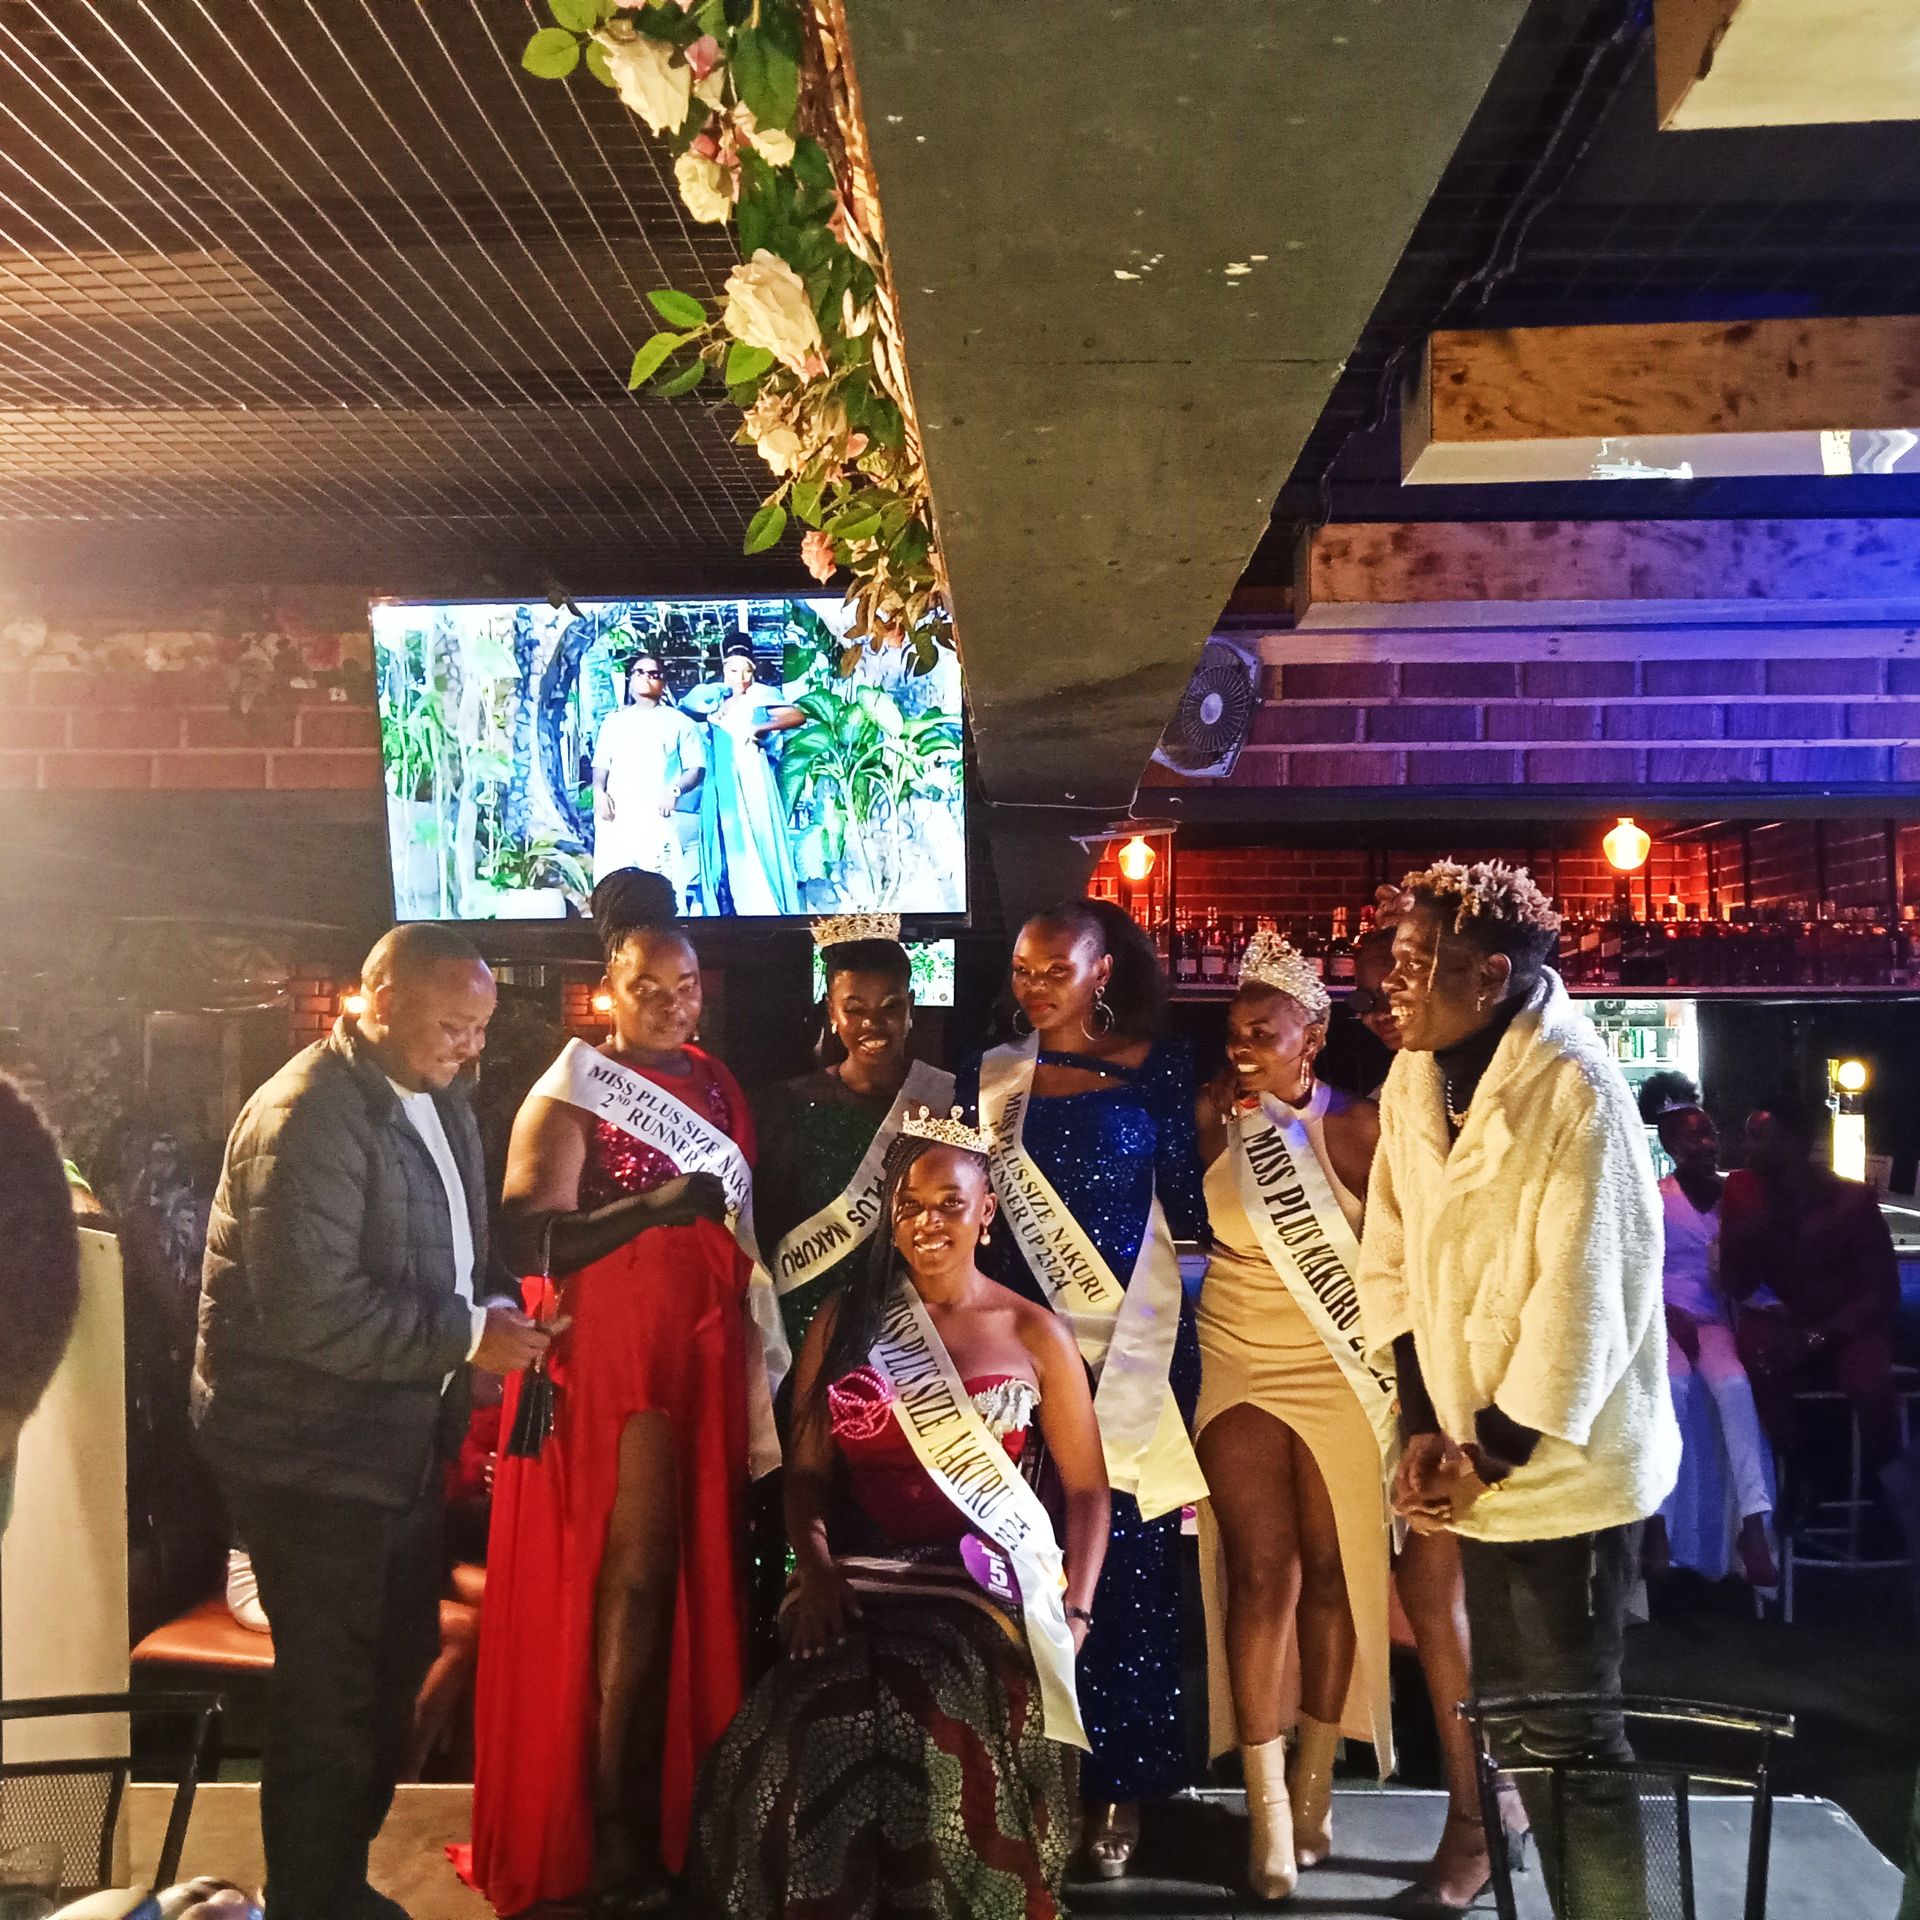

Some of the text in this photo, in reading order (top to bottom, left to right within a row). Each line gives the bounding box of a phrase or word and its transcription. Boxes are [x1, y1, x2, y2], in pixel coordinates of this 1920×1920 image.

[588, 1065, 636, 1096] MISS
[636, 1089, 683, 1125] PLUS
[682, 1120, 720, 1158] SIZE
[626, 1107, 699, 1168] RUNNER
[988, 1144, 1029, 1224] RUNNER
[1021, 1222, 1047, 1247] UP
[1035, 1246, 1073, 1292] 23/24
[999, 1091, 1110, 1304] MISS PLUS SIZE NAKURU
[1242, 1125, 1363, 1332] MISS PLUS NAKURU
[781, 1221, 852, 1278] NAKURU
[880, 1334, 942, 1388] PLUS
[902, 1380, 962, 1438] SIZE
[928, 1429, 1015, 1519] NAKURU
[989, 1557, 1008, 1587] 5
